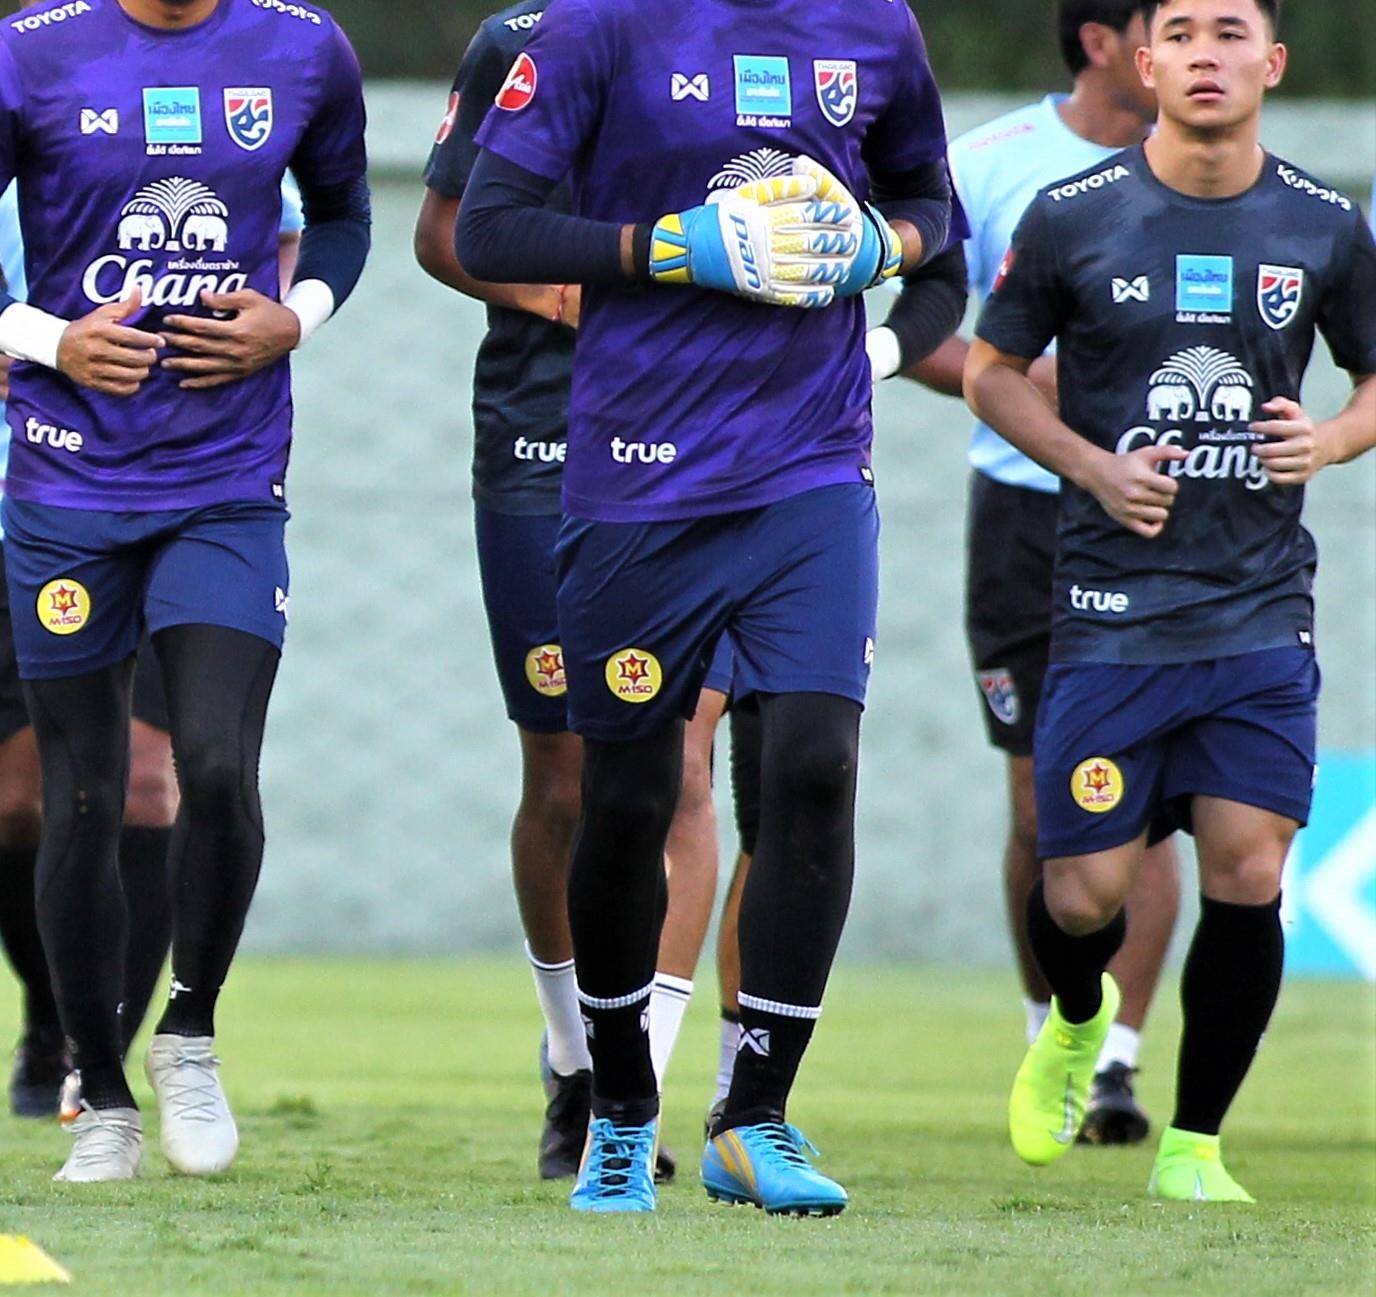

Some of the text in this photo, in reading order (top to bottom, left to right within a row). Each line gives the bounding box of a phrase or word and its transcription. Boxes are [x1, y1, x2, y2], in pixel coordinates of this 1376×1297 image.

[11, 1, 91, 32] TOYOTA
[504, 12, 543, 30] TOY
[1048, 164, 1130, 200] TOYOTA
[1277, 164, 1352, 210] Kubota
[82, 255, 247, 316] Chang
[26, 418, 82, 451] true
[515, 437, 567, 462] true
[611, 437, 676, 463] true
[1070, 585, 1128, 612] true
